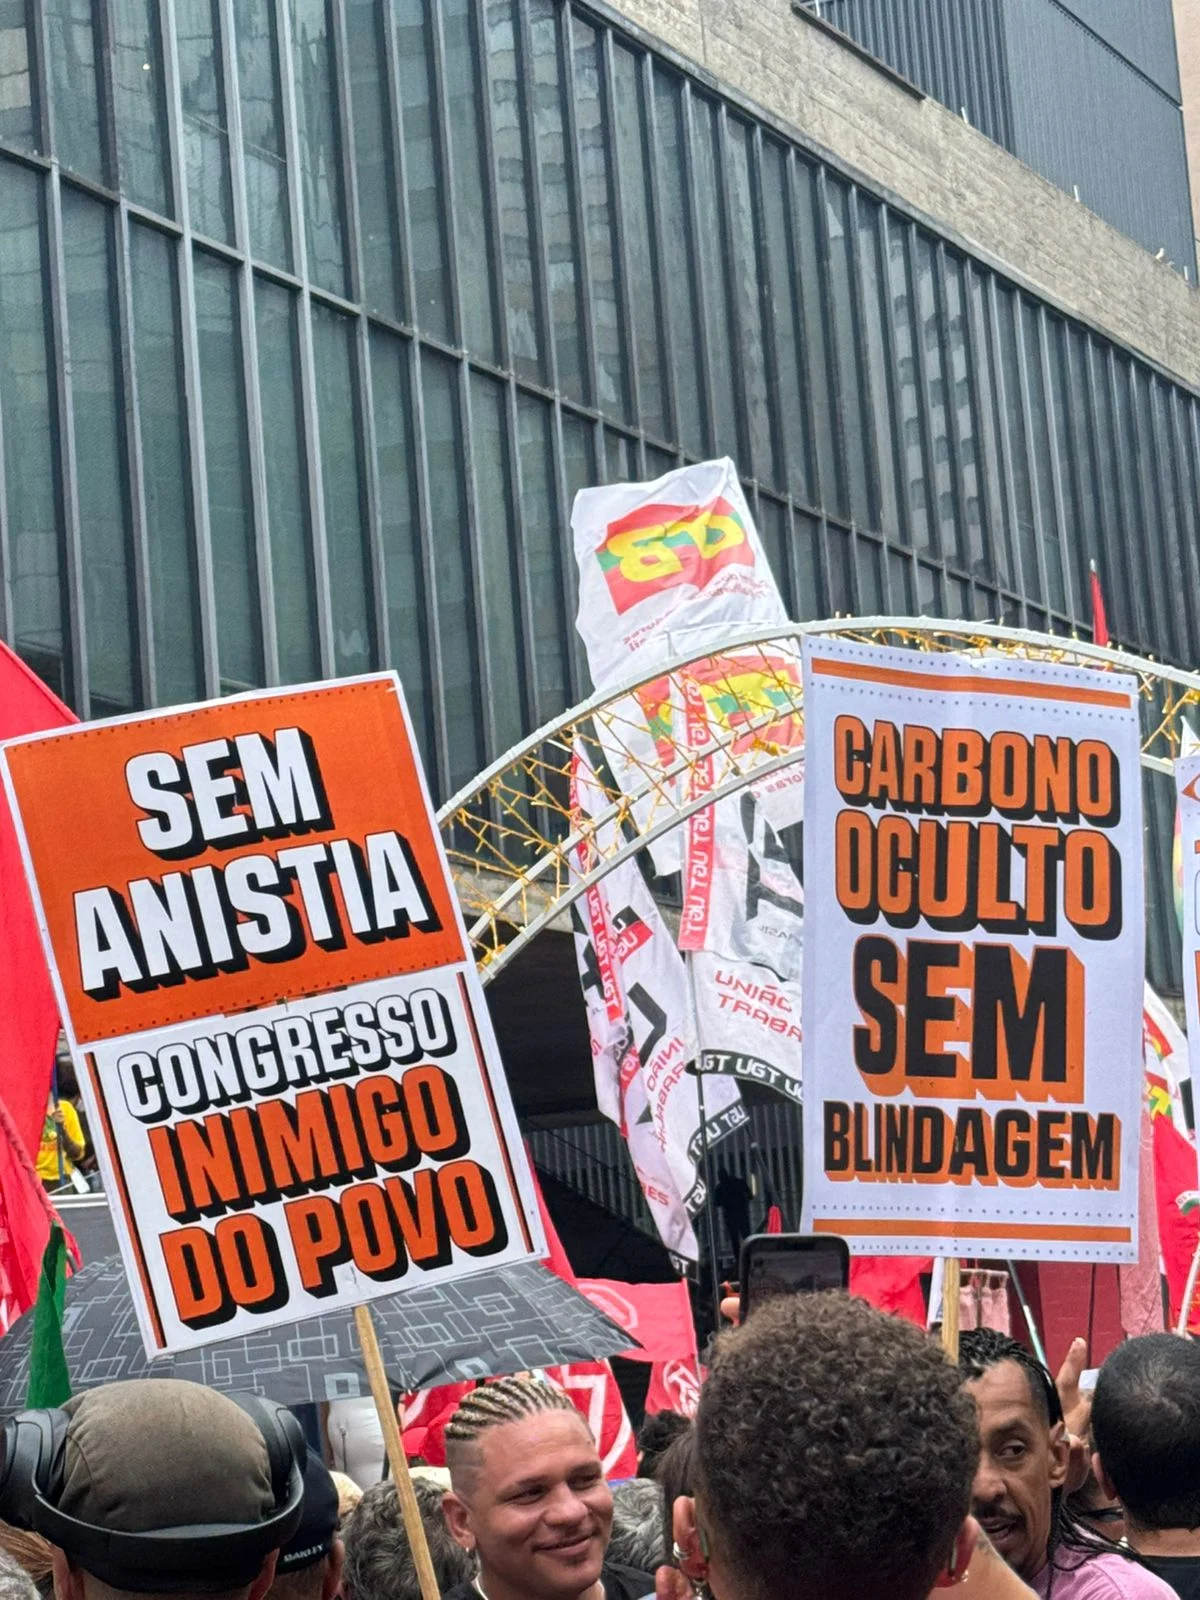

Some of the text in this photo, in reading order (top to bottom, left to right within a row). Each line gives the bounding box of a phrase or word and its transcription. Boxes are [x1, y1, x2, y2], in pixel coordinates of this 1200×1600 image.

[124, 727, 335, 861] SEM
[834, 714, 1121, 828] CARBONO
[73, 831, 443, 1000] ANISTIA
[834, 809, 1122, 941] OCULTO
[596, 931, 610, 967] UGT
[601, 972, 619, 1008] UGT
[117, 988, 457, 1123] CONGRESSO
[718, 992, 803, 1043] TRABA
[735, 1057, 780, 1085] UGT
[852, 932, 1086, 1104] SEM
[147, 1065, 472, 1224] INIMIGO
[823, 1100, 1122, 1191] BLINDAGEM
[159, 1159, 510, 1330] DO POVO
